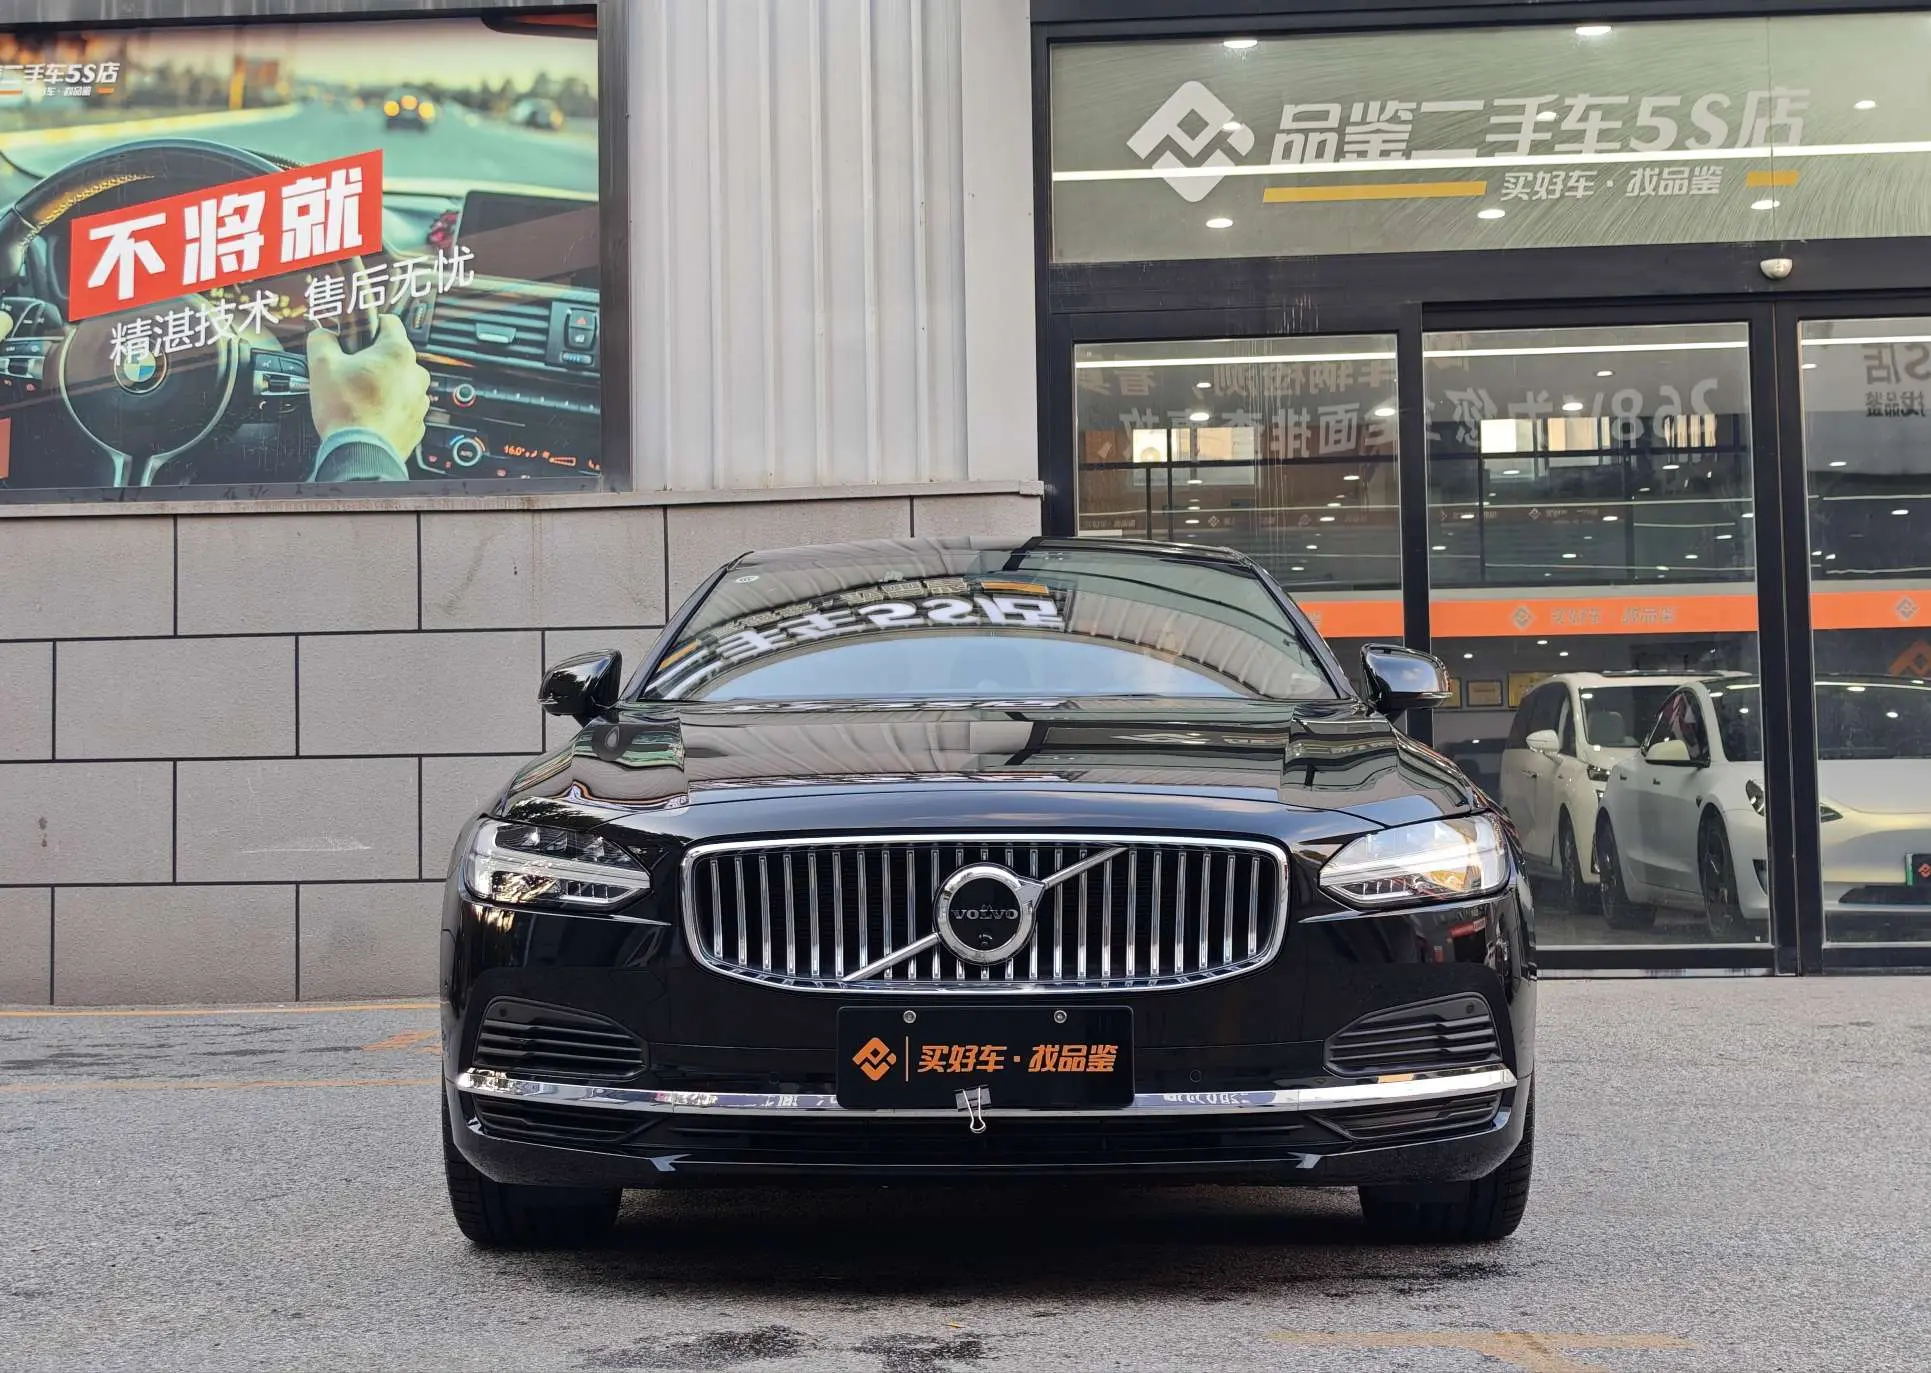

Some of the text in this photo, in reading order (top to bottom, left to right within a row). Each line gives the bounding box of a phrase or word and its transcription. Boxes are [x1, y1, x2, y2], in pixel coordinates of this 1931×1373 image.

[0, 62, 120, 84] 二手车5S店
[1270, 86, 1810, 165] 品鉴二手车5S店
[88, 166, 363, 301] 不将就
[109, 245, 476, 366] 精湛技术 售后无忧
[951, 908, 1019, 920] VOLVO
[917, 1044, 1119, 1073] 买好车·找品鉴
